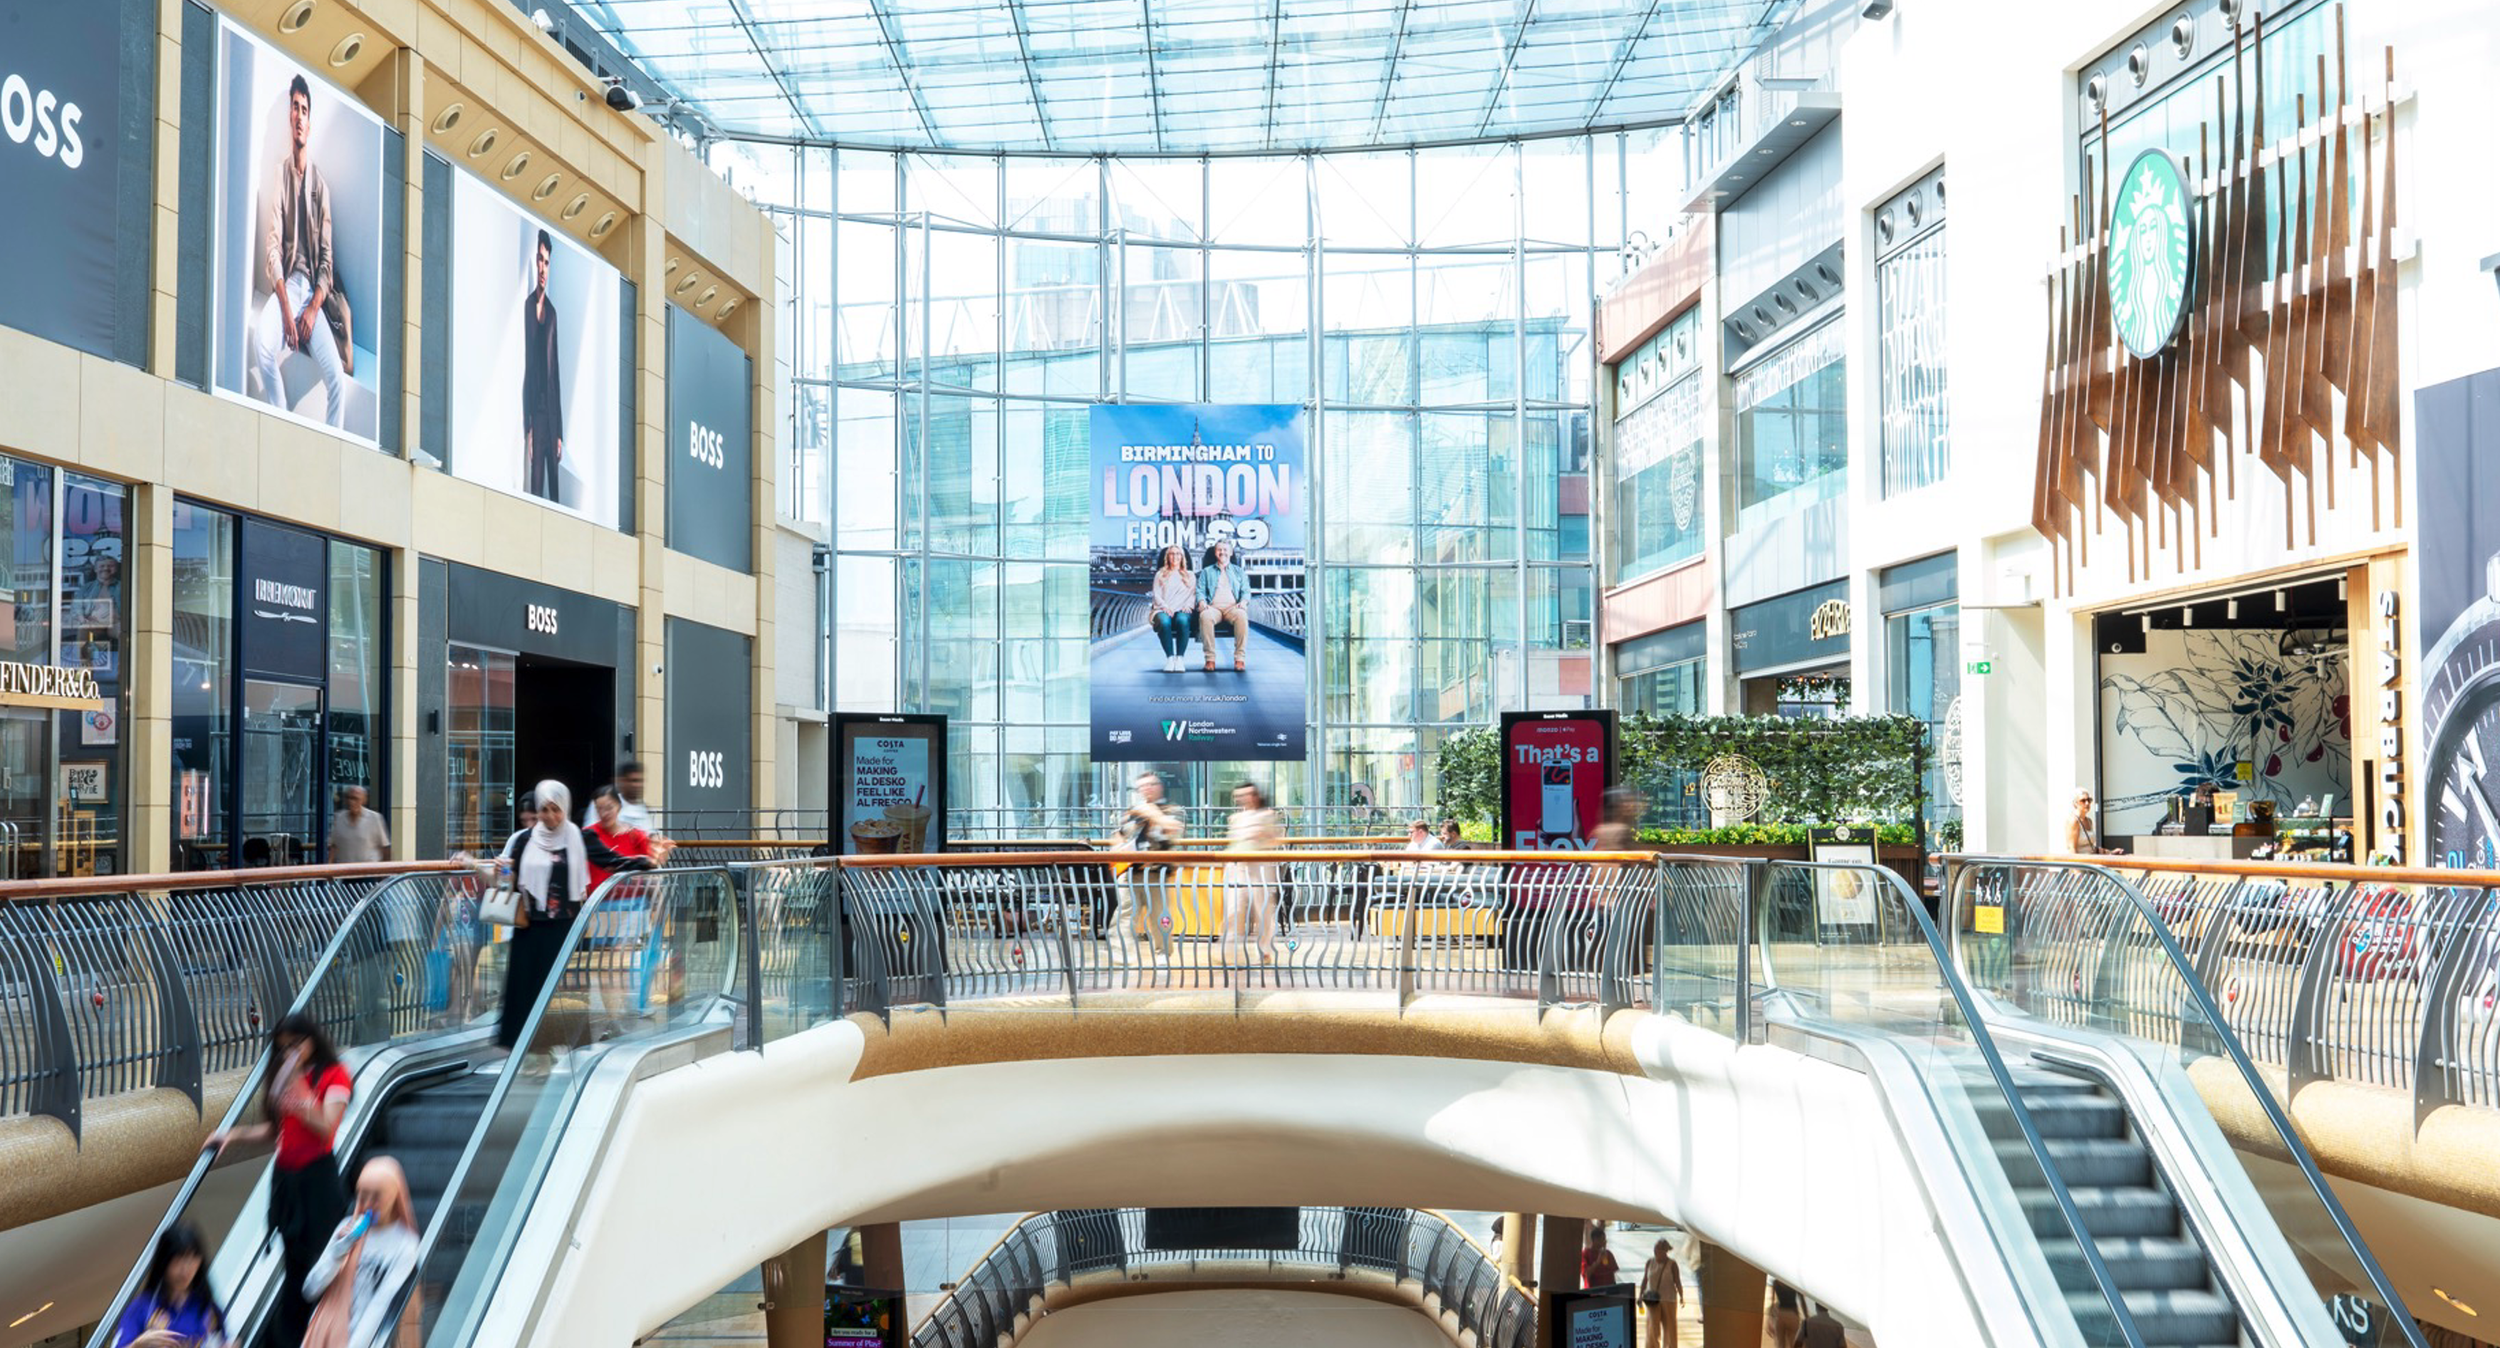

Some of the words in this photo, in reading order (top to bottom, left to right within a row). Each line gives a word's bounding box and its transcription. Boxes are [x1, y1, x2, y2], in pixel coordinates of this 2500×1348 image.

[1, 73, 84, 169] OSS
[690, 420, 724, 470] BOSS
[1121, 445, 1250, 462] BIRMINGHAM
[1256, 445, 1274, 461] TO
[1104, 463, 1290, 517] LONDON
[1126, 520, 1196, 549] FROM
[1204, 519, 1270, 550] £9
[528, 603, 558, 635] BOSS
[877, 740, 905, 748] COSTA
[856, 756, 881, 765] Made
[882, 756, 894, 765] for
[1515, 744, 1582, 764] That's
[1586, 746, 1598, 762] a
[690, 750, 724, 788] BOSS
[856, 766, 898, 775] MAKING
[856, 777, 871, 786] AL
[872, 777, 906, 786] DESKO
[856, 788, 883, 796] FEEL
[883, 788, 905, 796] LIKE
[856, 798, 871, 807] AL
[828, 1339, 855, 1347] Summer
